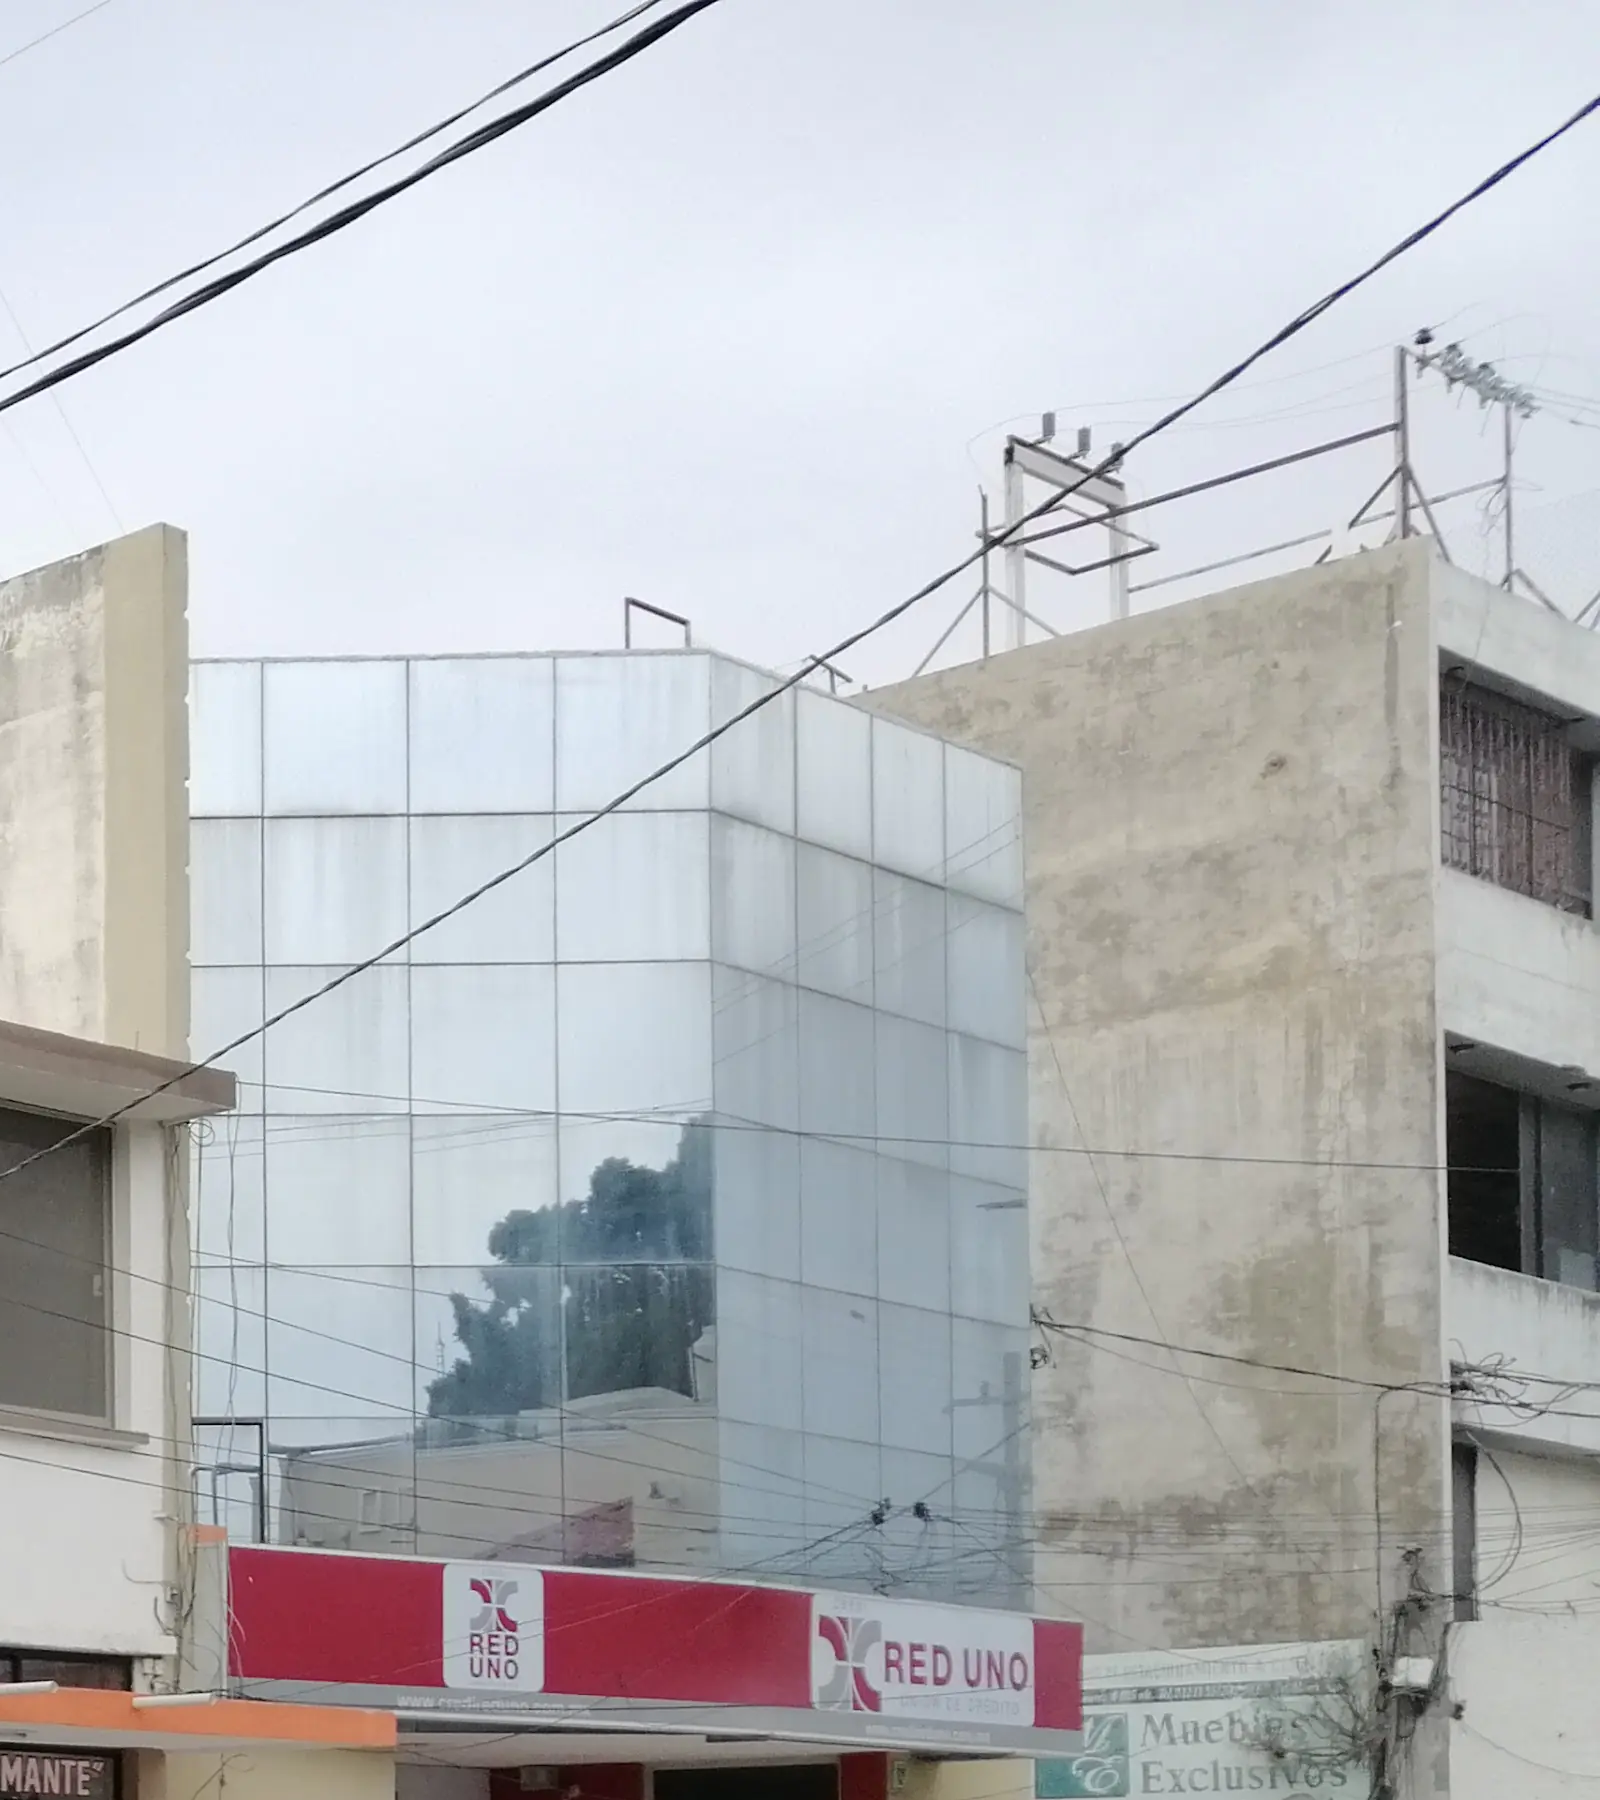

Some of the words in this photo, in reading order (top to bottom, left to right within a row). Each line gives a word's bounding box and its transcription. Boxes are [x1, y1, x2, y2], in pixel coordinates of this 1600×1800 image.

[469, 1632, 519, 1656] RED
[469, 1656, 519, 1680] UNO
[884, 1639, 953, 1687] RED
[962, 1647, 1029, 1692] UNO
[1140, 1759, 1348, 1795] Exclusivos
